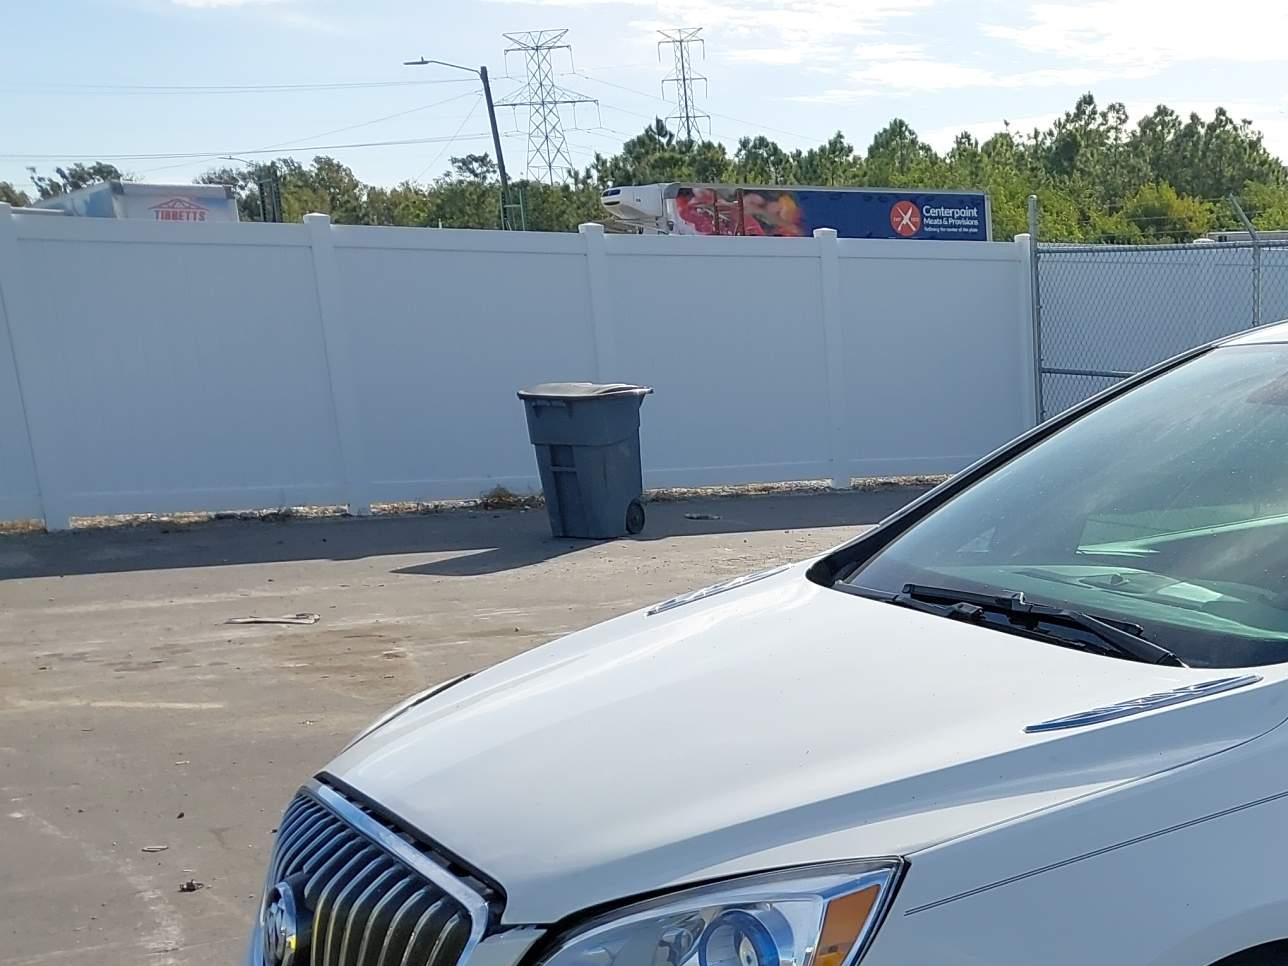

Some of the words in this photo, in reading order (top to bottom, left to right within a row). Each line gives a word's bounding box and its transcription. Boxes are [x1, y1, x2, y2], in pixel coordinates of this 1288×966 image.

[923, 205, 978, 219] Centerpoint
[923, 217, 943, 225] Meats
[949, 217, 979, 226] Provisions
